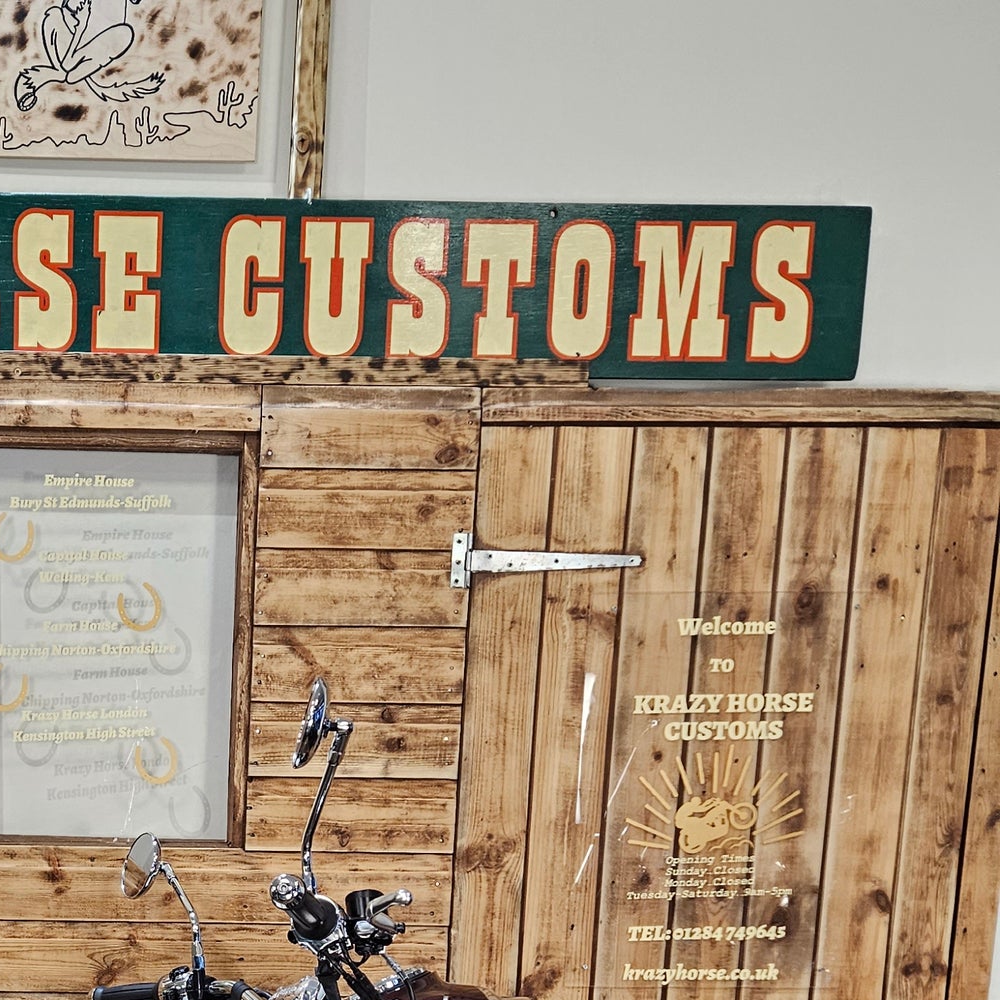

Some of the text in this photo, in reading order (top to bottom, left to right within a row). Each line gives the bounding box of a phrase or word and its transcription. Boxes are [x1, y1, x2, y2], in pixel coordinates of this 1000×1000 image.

[219, 215, 816, 362] CUSTOMS
[43, 473, 135, 489] Empire House
[9, 495, 172, 512] Bury St Edmunds-Suffolk
[677, 616, 776, 636] Welcome
[52, 642, 176, 657] Norton-Oxfordshire
[709, 658, 735, 673] TO
[633, 692, 815, 714] KRAZY HORSE
[21, 706, 148, 723] Krazy Horse London
[13, 727, 157, 744] Kensington High Street
[663, 720, 784, 741] CUSTOMS
[665, 855, 756, 866] Opening Times
[628, 925, 786, 942] TEL: 01284 749645
[622, 963, 779, 985] krazyhorse.co.uk
